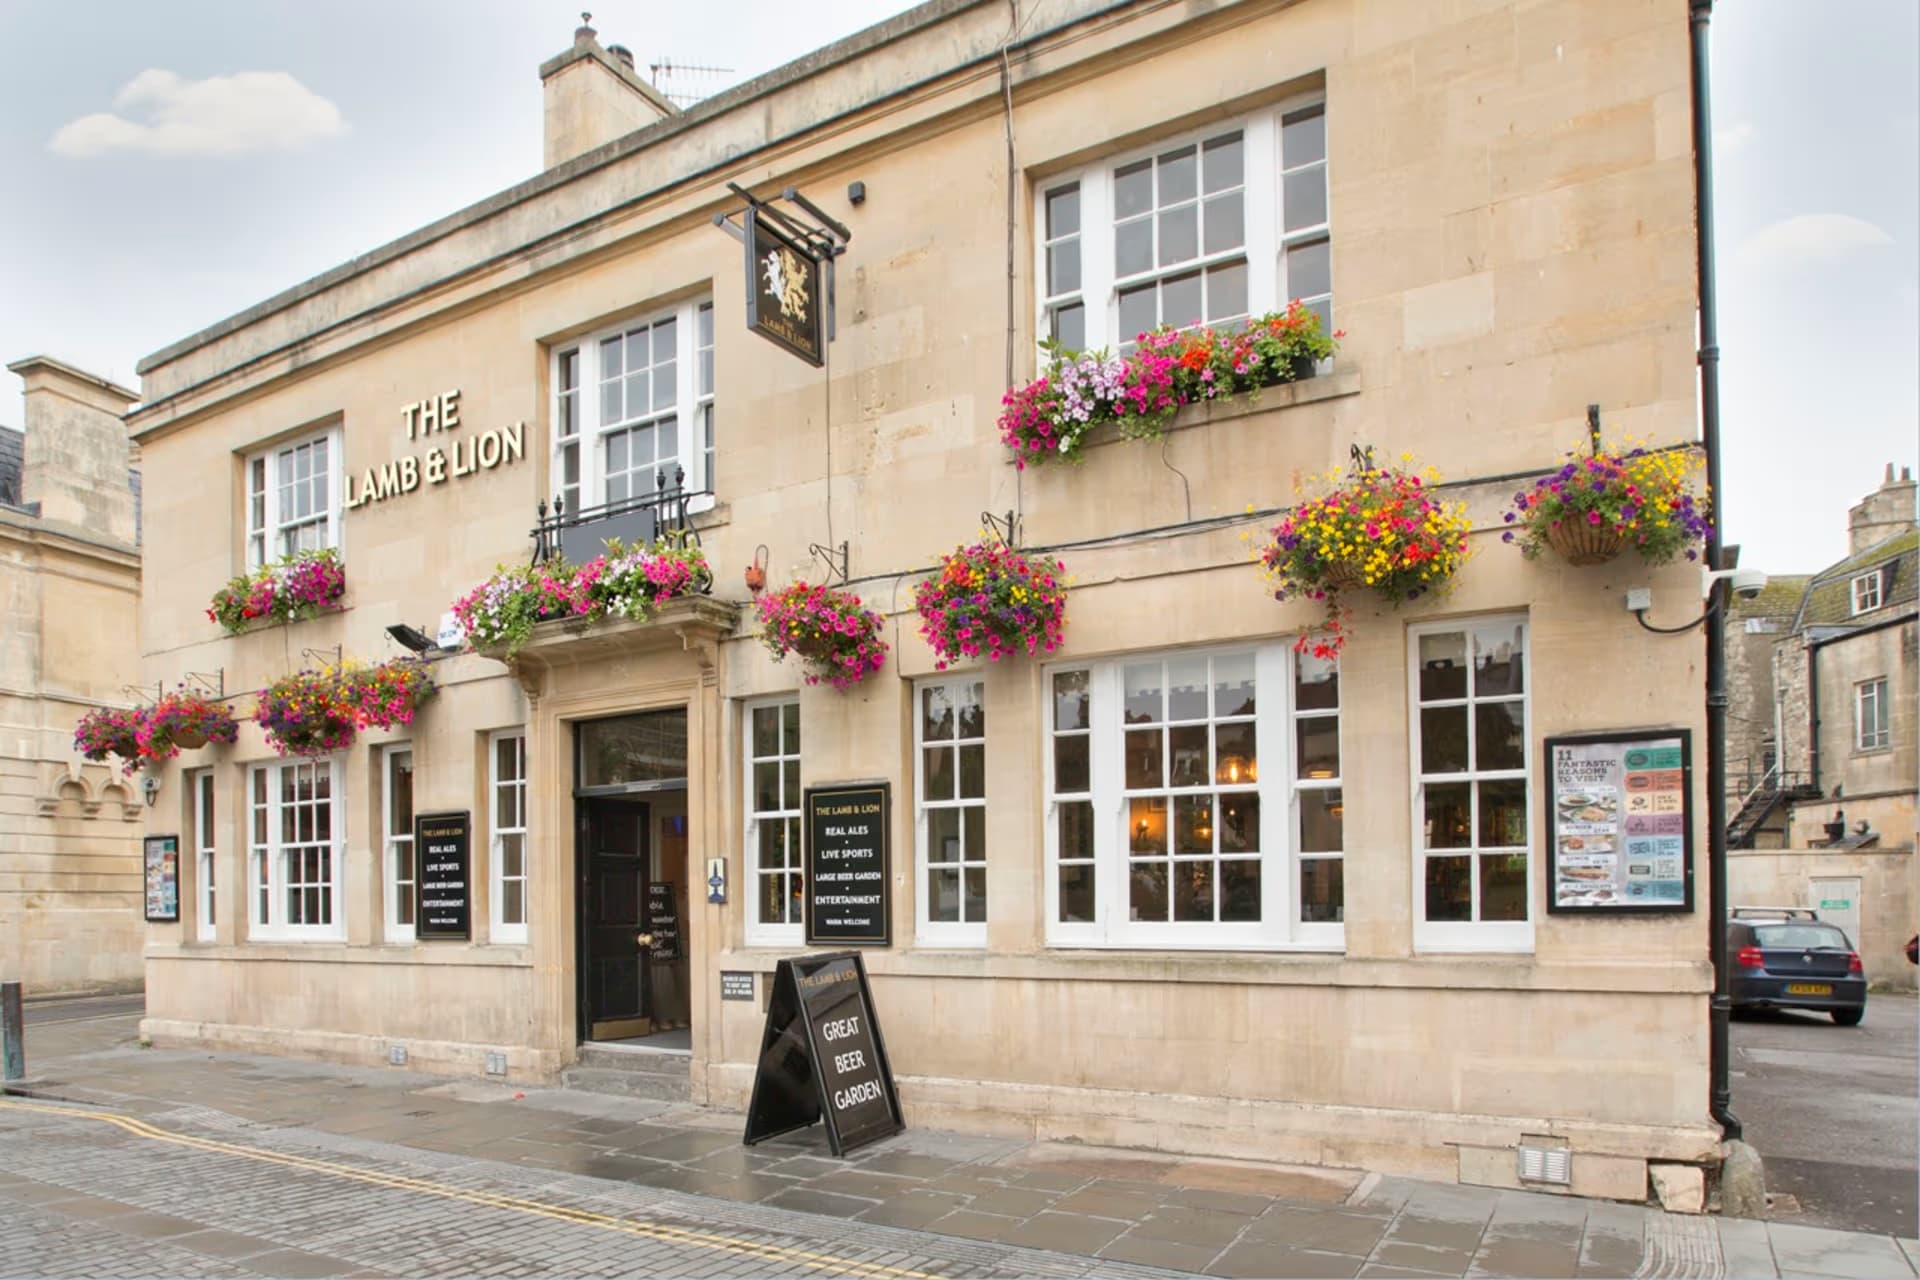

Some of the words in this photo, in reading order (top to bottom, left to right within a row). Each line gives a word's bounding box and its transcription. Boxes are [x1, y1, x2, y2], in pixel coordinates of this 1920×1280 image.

[400, 389, 460, 440] THE
[344, 456, 420, 509] LAMB
[425, 447, 446, 484] &
[452, 421, 525, 477] LION
[1558, 749, 1572, 761] 11
[1558, 760, 1617, 768] FANTASTIC
[1558, 768, 1608, 776] REASONS
[1576, 774, 1605, 783] VISIT
[816, 807, 831, 816] THE
[832, 806, 852, 815] LAMB
[853, 805, 860, 814] &
[861, 803, 880, 813] LION
[825, 827, 846, 836] REAL
[848, 825, 869, 835] ALES
[429, 845, 442, 854] REAL
[443, 844, 457, 853] ALES
[821, 850, 840, 859] LIVE
[841, 848, 873, 859] SPORTS
[426, 863, 438, 872] LIVE
[439, 862, 460, 871] SPORTS
[816, 873, 836, 881] LARGE
[837, 872, 854, 881] BEER
[854, 871, 882, 880] GARDEN
[423, 899, 464, 907] ENTERTAINMENT
[815, 895, 881, 905] ENTERTAINMENT
[843, 918, 871, 926] WELCOME
[800, 976, 816, 987] THE
[823, 1016, 860, 1042] GREAT
[834, 1050, 866, 1075] BEER
[834, 1079, 882, 1111] GARDEN
